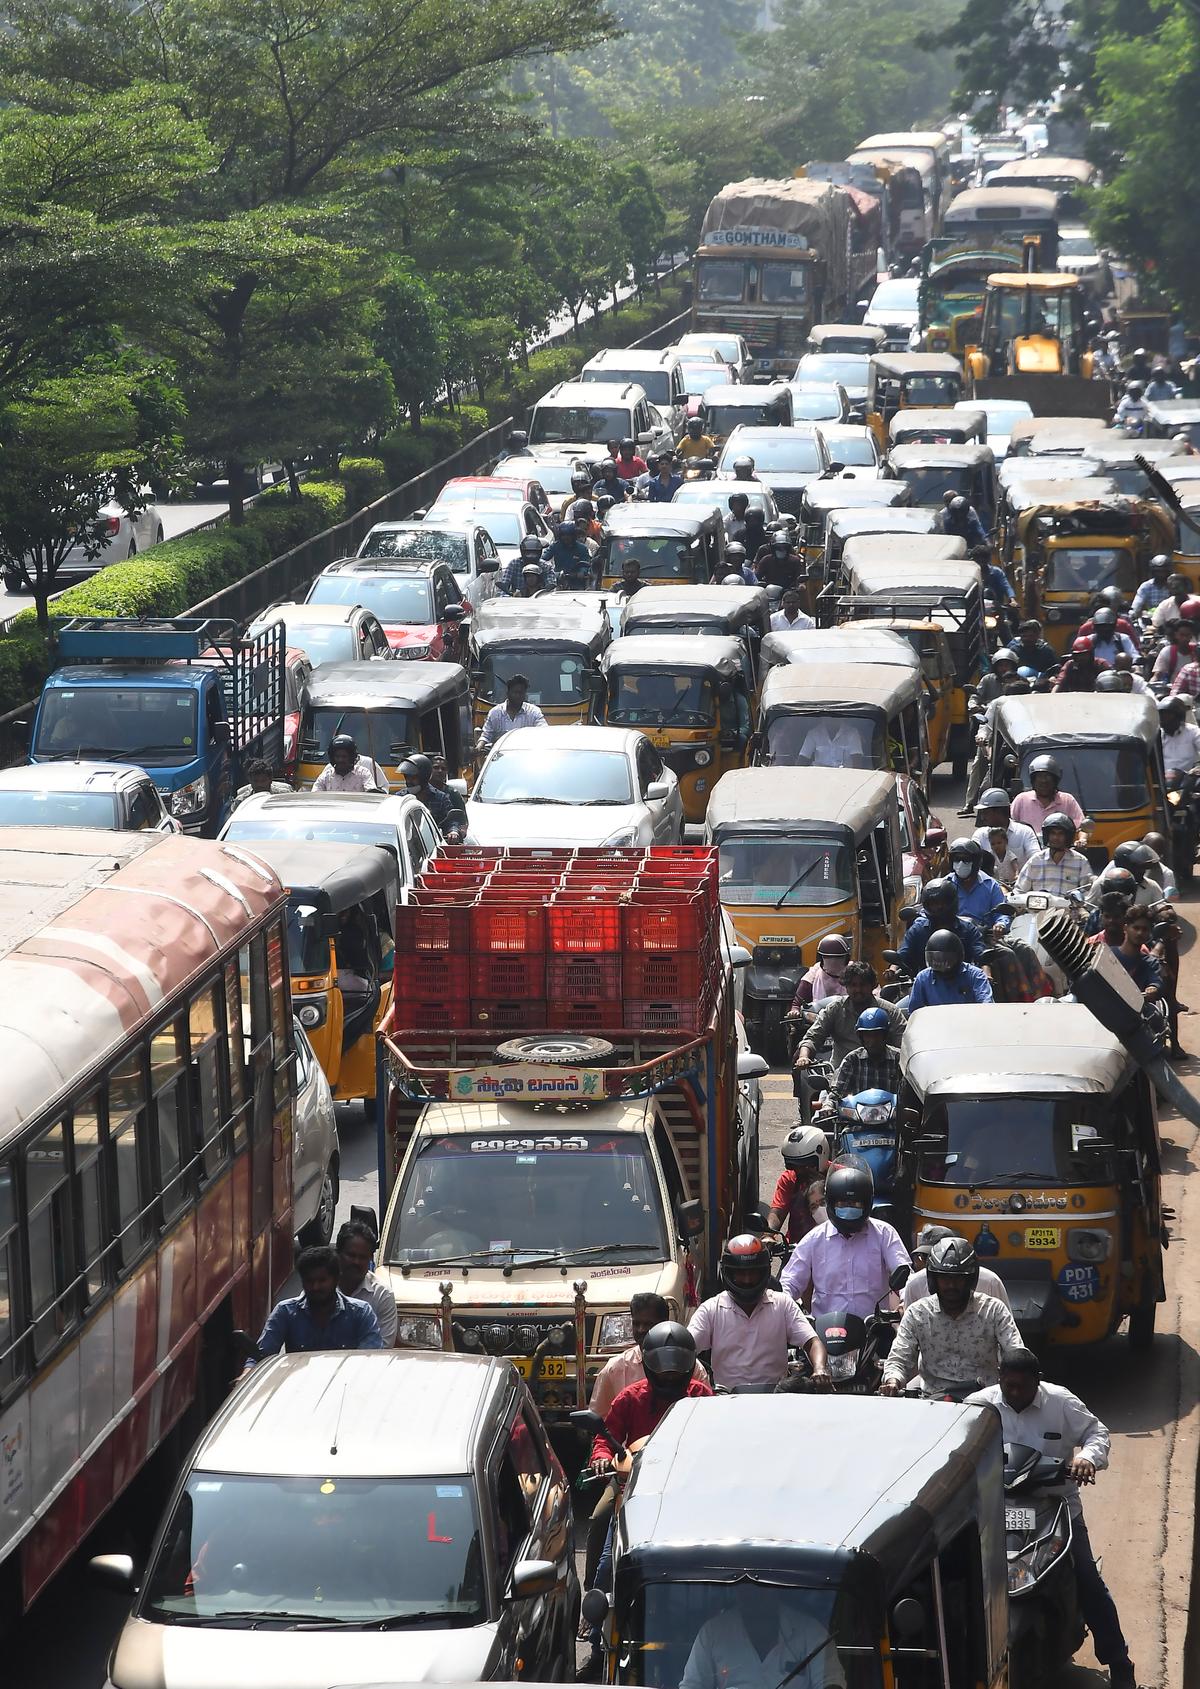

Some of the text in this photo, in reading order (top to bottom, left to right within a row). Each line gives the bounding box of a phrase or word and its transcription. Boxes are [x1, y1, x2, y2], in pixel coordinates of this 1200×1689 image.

[1031, 1229, 1054, 1237] AP31TA
[1028, 1237, 1056, 1246] 5934
[1064, 1266, 1094, 1282] PDT
[1067, 1283, 1093, 1300] 431
[474, 1324, 514, 1332] ASK
